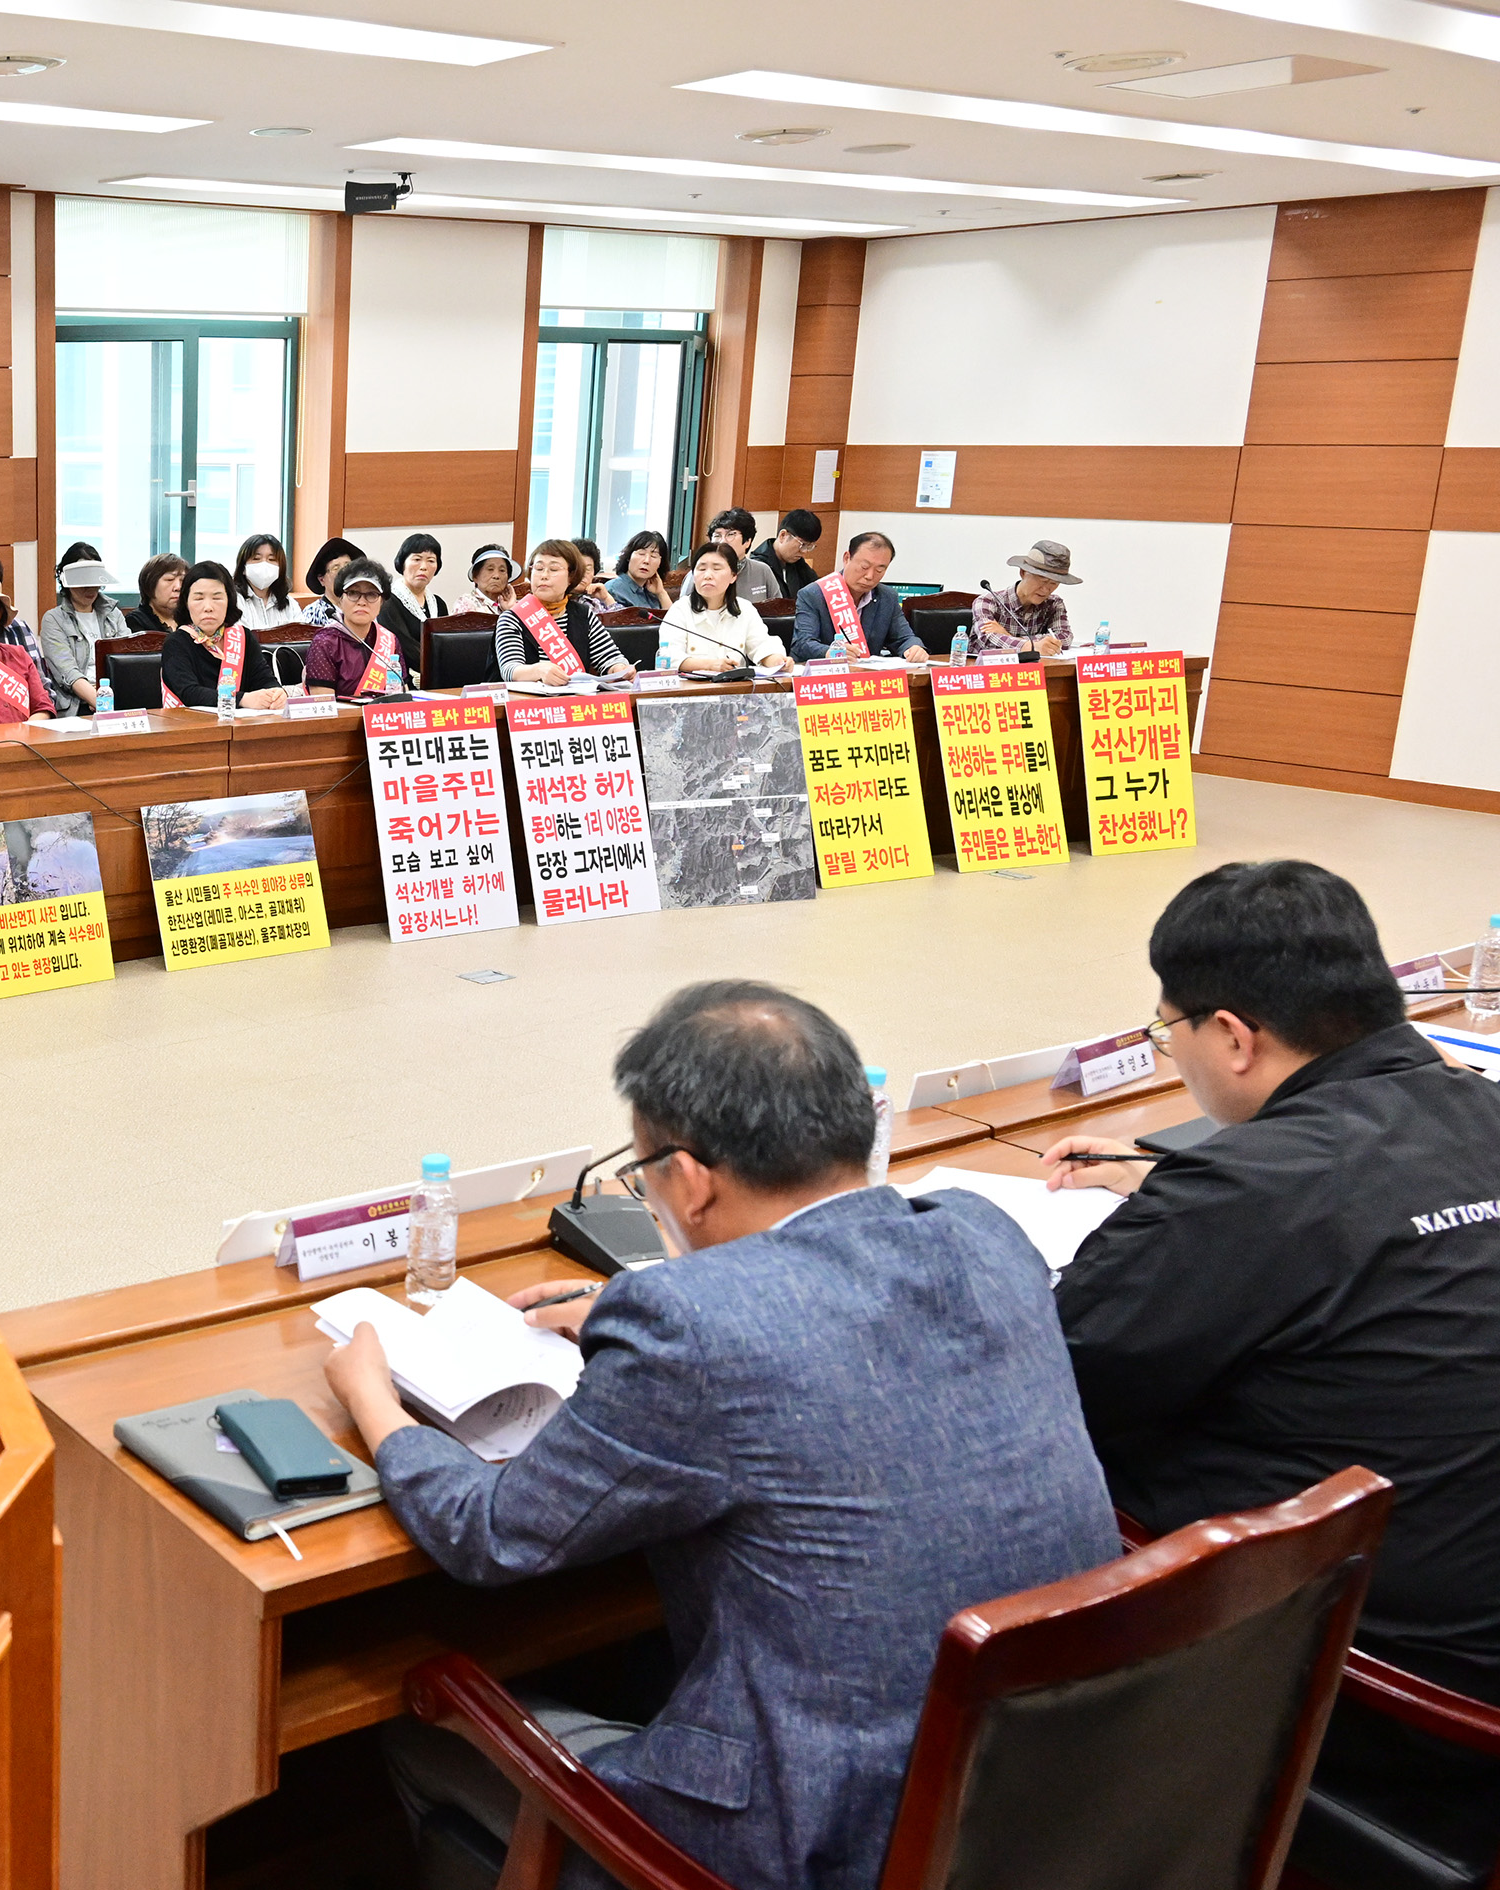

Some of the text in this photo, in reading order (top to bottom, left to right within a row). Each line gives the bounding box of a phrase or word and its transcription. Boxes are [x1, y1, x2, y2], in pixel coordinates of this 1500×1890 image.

[539, 622, 582, 674] 석산개
[938, 670, 1042, 691] 석산개발 결사 반대
[1082, 658, 1181, 678] 석산개발 결사 반대
[799, 678, 904, 700] 석산개발 결사 반대
[1088, 684, 1179, 720] 환경파괴
[370, 706, 491, 731] 석산개발 결사 반대
[514, 701, 628, 725] 석산개발 결사 반대
[804, 708, 906, 738] 대복석산개발허가
[942, 700, 1034, 736] 주민건강 담보로
[378, 734, 490, 768] 주민대표는
[520, 734, 632, 770] 주민과 협의 않고
[808, 741, 910, 772] 꿈도 꾸지마라
[948, 740, 1050, 778] 찬성하는 무리들의
[1091, 722, 1181, 764] 석산개발
[383, 768, 496, 804] 마을주민
[526, 770, 634, 806] 채석장 허가
[814, 777, 910, 807] 저승까지라도
[954, 782, 1045, 820] 어리석은 발상에
[1096, 768, 1170, 802] 그 누가
[388, 808, 500, 844] 죽어가는
[531, 804, 643, 844] 동의하는 1리 이장은
[819, 813, 884, 840] 따라가서
[1098, 807, 1188, 846] 찬성했나?
[392, 844, 494, 874] 모습 보고 싶어
[960, 822, 1062, 863] 주민들은 분노한다
[536, 841, 648, 880] 당장 그자리에서
[824, 844, 910, 876] 말릴 것이다
[164, 872, 314, 908] 울산 시민들의 주 식수인 회야강 상류의
[395, 871, 506, 904] 석산개발 허가에
[542, 880, 630, 918] 물러나라
[40, 906, 58, 923] 사진
[60, 901, 91, 921] 입니다.
[268, 896, 306, 917] 골재채취)
[398, 903, 478, 935] 앞장서느냐!
[8, 932, 46, 953] 위치하여
[48, 929, 67, 946] 계속
[68, 922, 104, 942] 식수원이
[260, 921, 311, 944] 울주폐차장의
[12, 961, 30, 979] 있는
[32, 952, 82, 975] 현장입니다.
[1410, 1200, 1500, 1235] NATION
